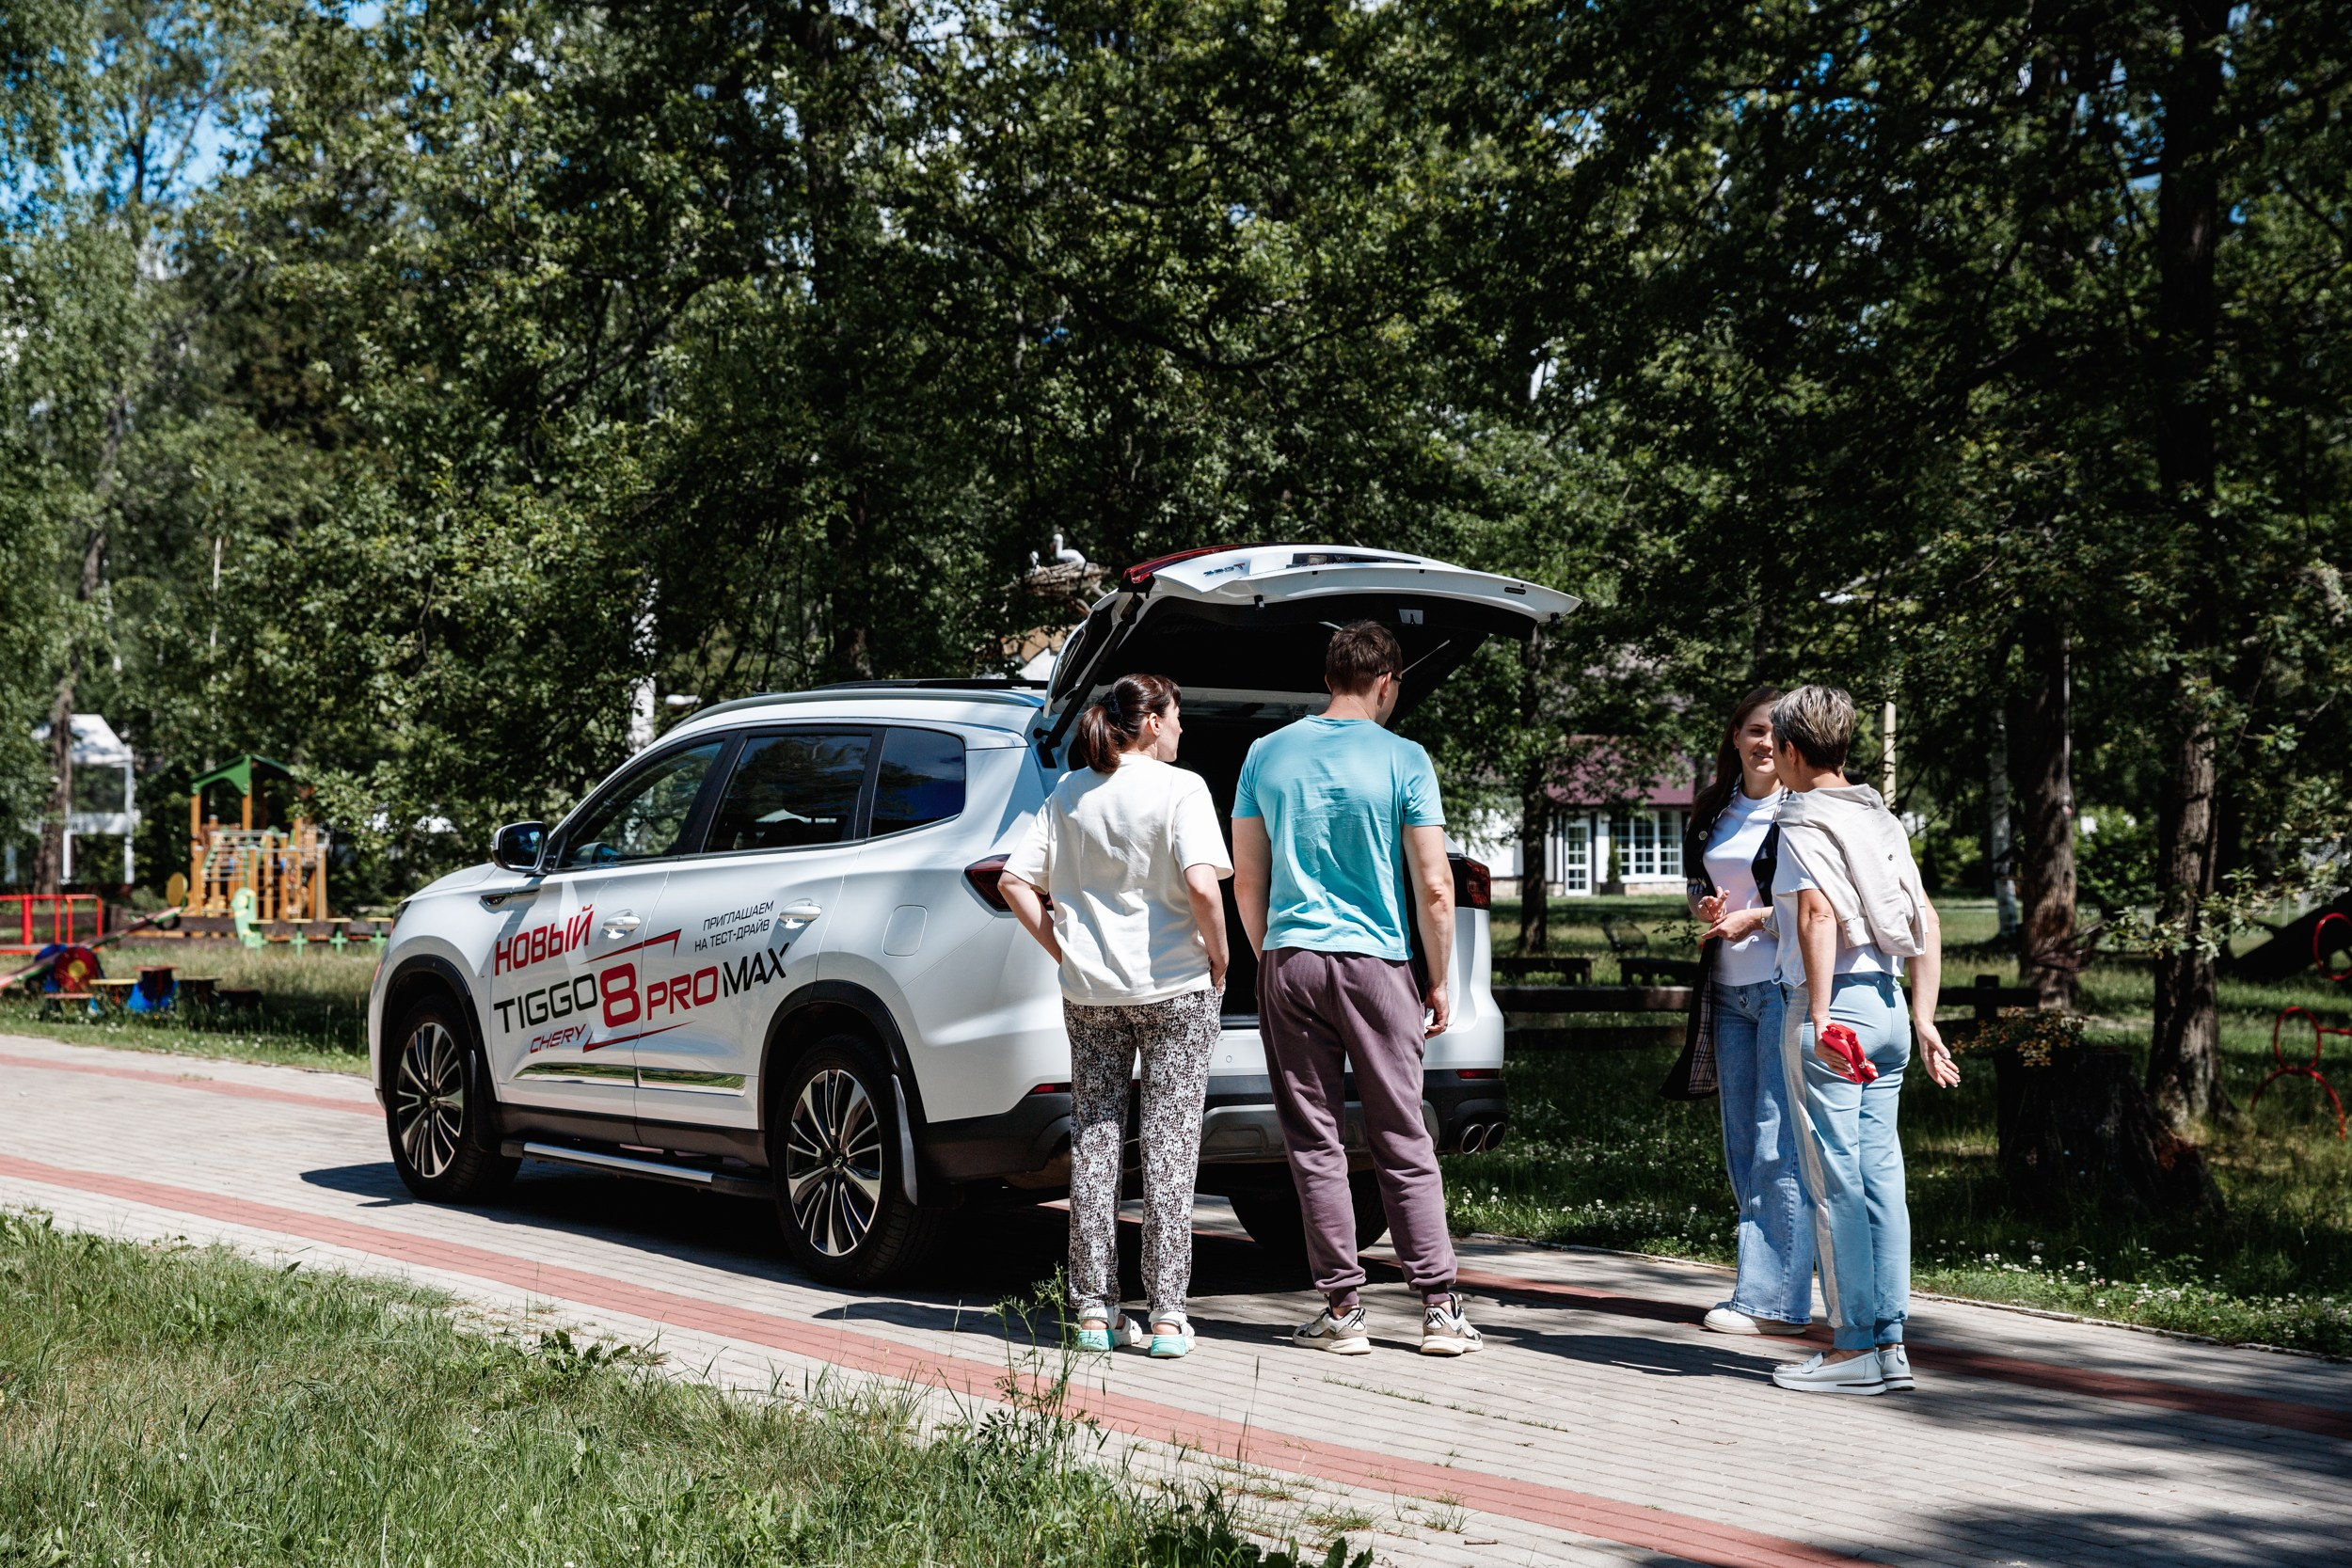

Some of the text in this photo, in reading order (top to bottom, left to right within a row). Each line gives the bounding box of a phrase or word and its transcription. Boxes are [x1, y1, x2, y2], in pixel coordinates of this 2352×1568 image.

[703, 900, 774, 931] ПРИГЛАШАЕМ
[494, 904, 595, 976] НОВЫЙ
[694, 918, 771, 953] НА ТЕСТ-ДРАЙВ
[493, 942, 790, 1034] TIGGO 8 PRO MAX
[530, 1023, 587, 1054] CHERY
